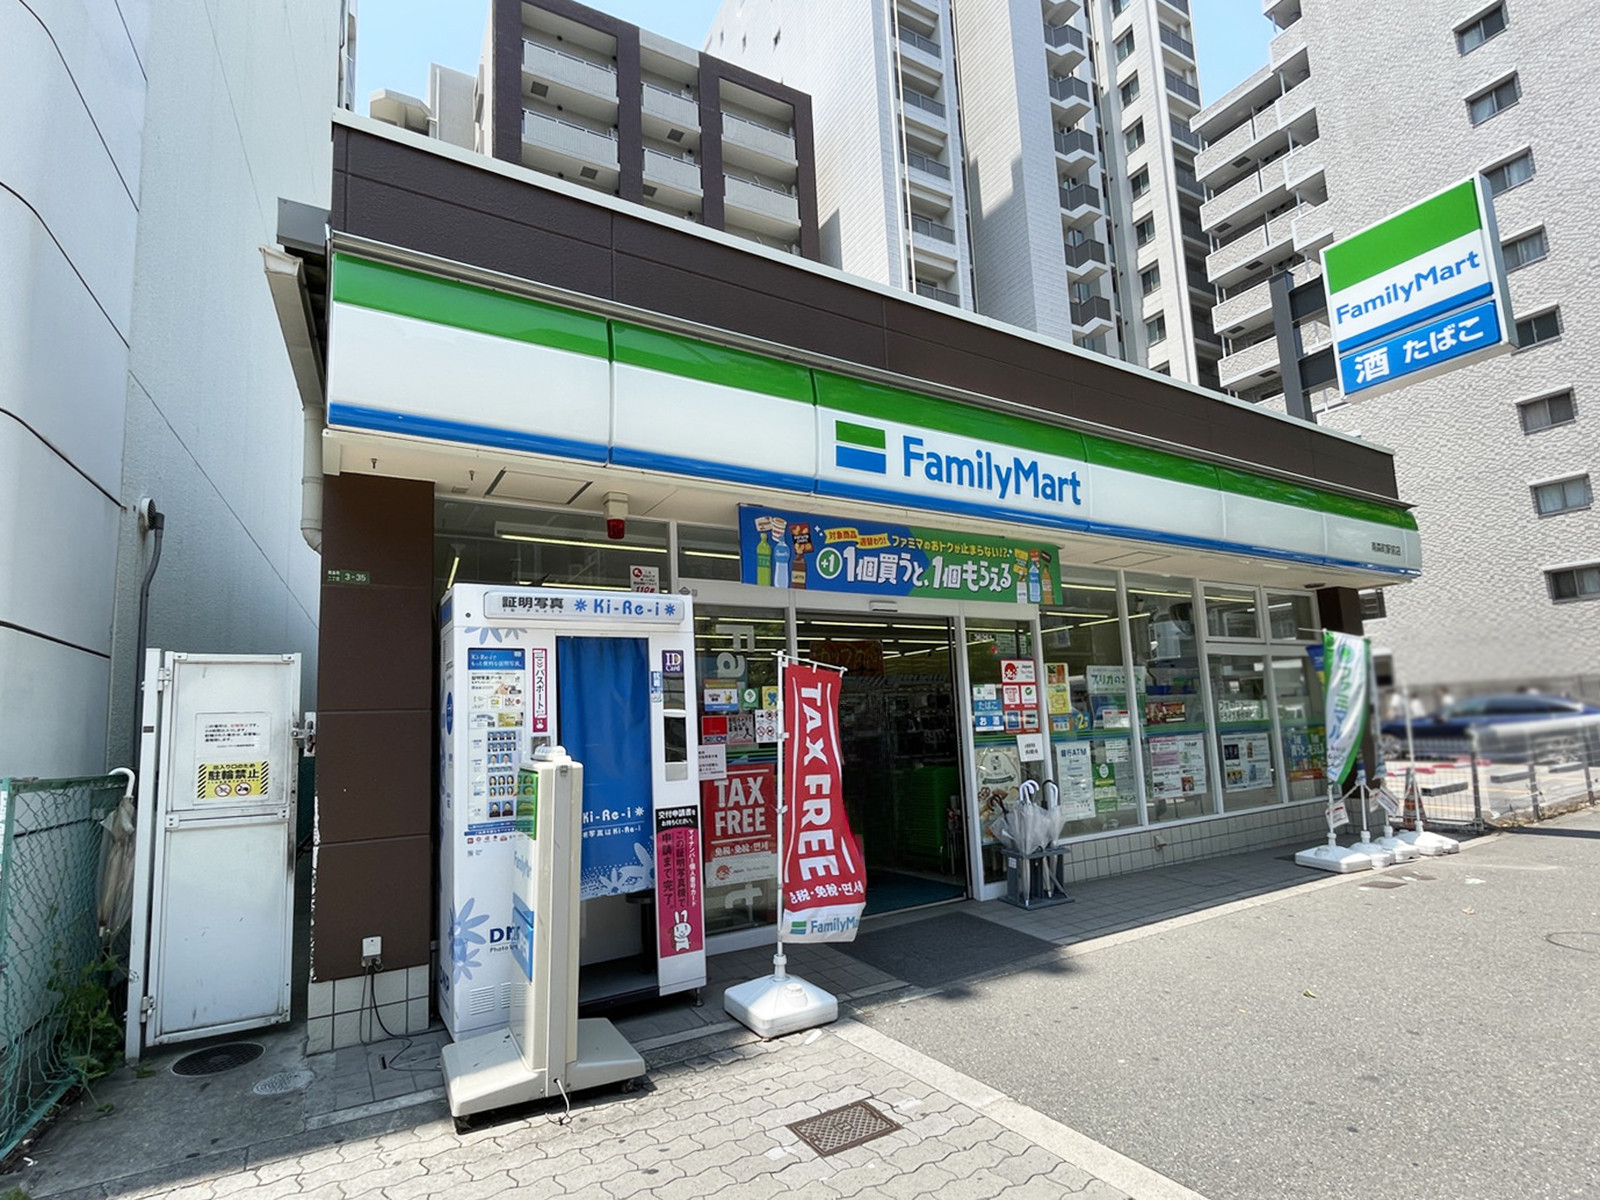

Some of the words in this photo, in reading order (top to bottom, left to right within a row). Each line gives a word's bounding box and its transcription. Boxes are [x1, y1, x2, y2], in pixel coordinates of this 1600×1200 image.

[1335, 251, 1480, 324] FamilyMart
[1354, 346, 1390, 384] 酒
[1402, 316, 1484, 364] たばこ
[902, 434, 1082, 506] FamilyMart
[502, 596, 564, 609] 証明写真
[593, 599, 660, 616] Ki-Re-i
[665, 652, 681, 665] ID
[800, 682, 828, 766] TAX
[207, 769, 260, 781] 駐輪禁止
[713, 776, 765, 808] TAX
[714, 807, 767, 837] FREE
[797, 773, 840, 881] FREE
